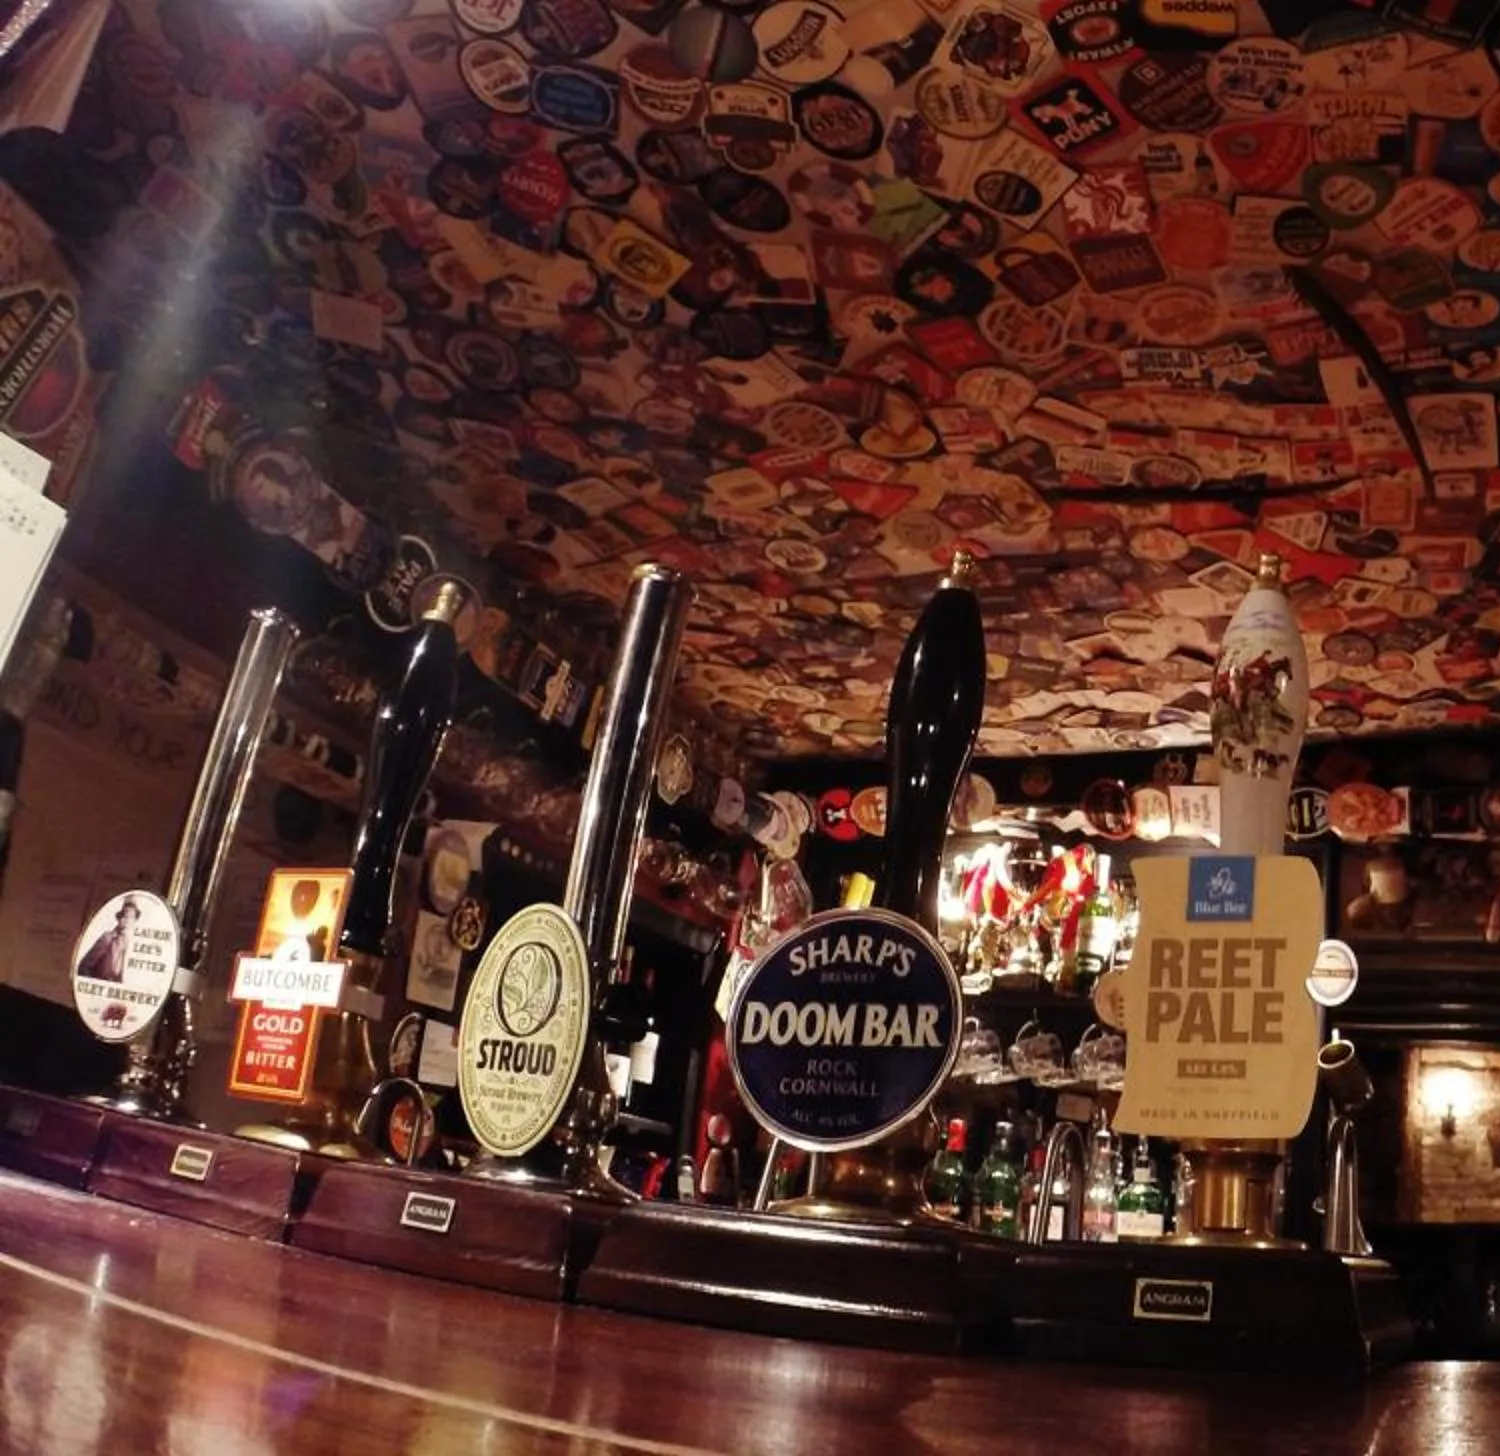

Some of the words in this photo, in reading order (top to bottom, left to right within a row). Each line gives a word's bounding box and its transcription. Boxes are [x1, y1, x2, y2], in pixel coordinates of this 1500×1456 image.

[1053, 112, 1112, 150] PONY
[1194, 901, 1220, 914] Blue
[1224, 902, 1247, 914] Bee
[127, 957, 167, 974] BITTER
[789, 934, 916, 977] SHARP'S
[1150, 938, 1287, 988] REET
[242, 970, 334, 993] BUTCOMBE
[253, 1013, 305, 1035] GOLD
[740, 1001, 858, 1047] DOOM
[861, 1003, 944, 1048] BAR
[1145, 991, 1286, 1044] PALE
[245, 1050, 297, 1070] BITTER
[476, 1038, 557, 1077] STROUD
[806, 1059, 858, 1076] ROCK
[779, 1077, 881, 1097] CORNWALL
[1143, 1291, 1206, 1308] ANGRAM
